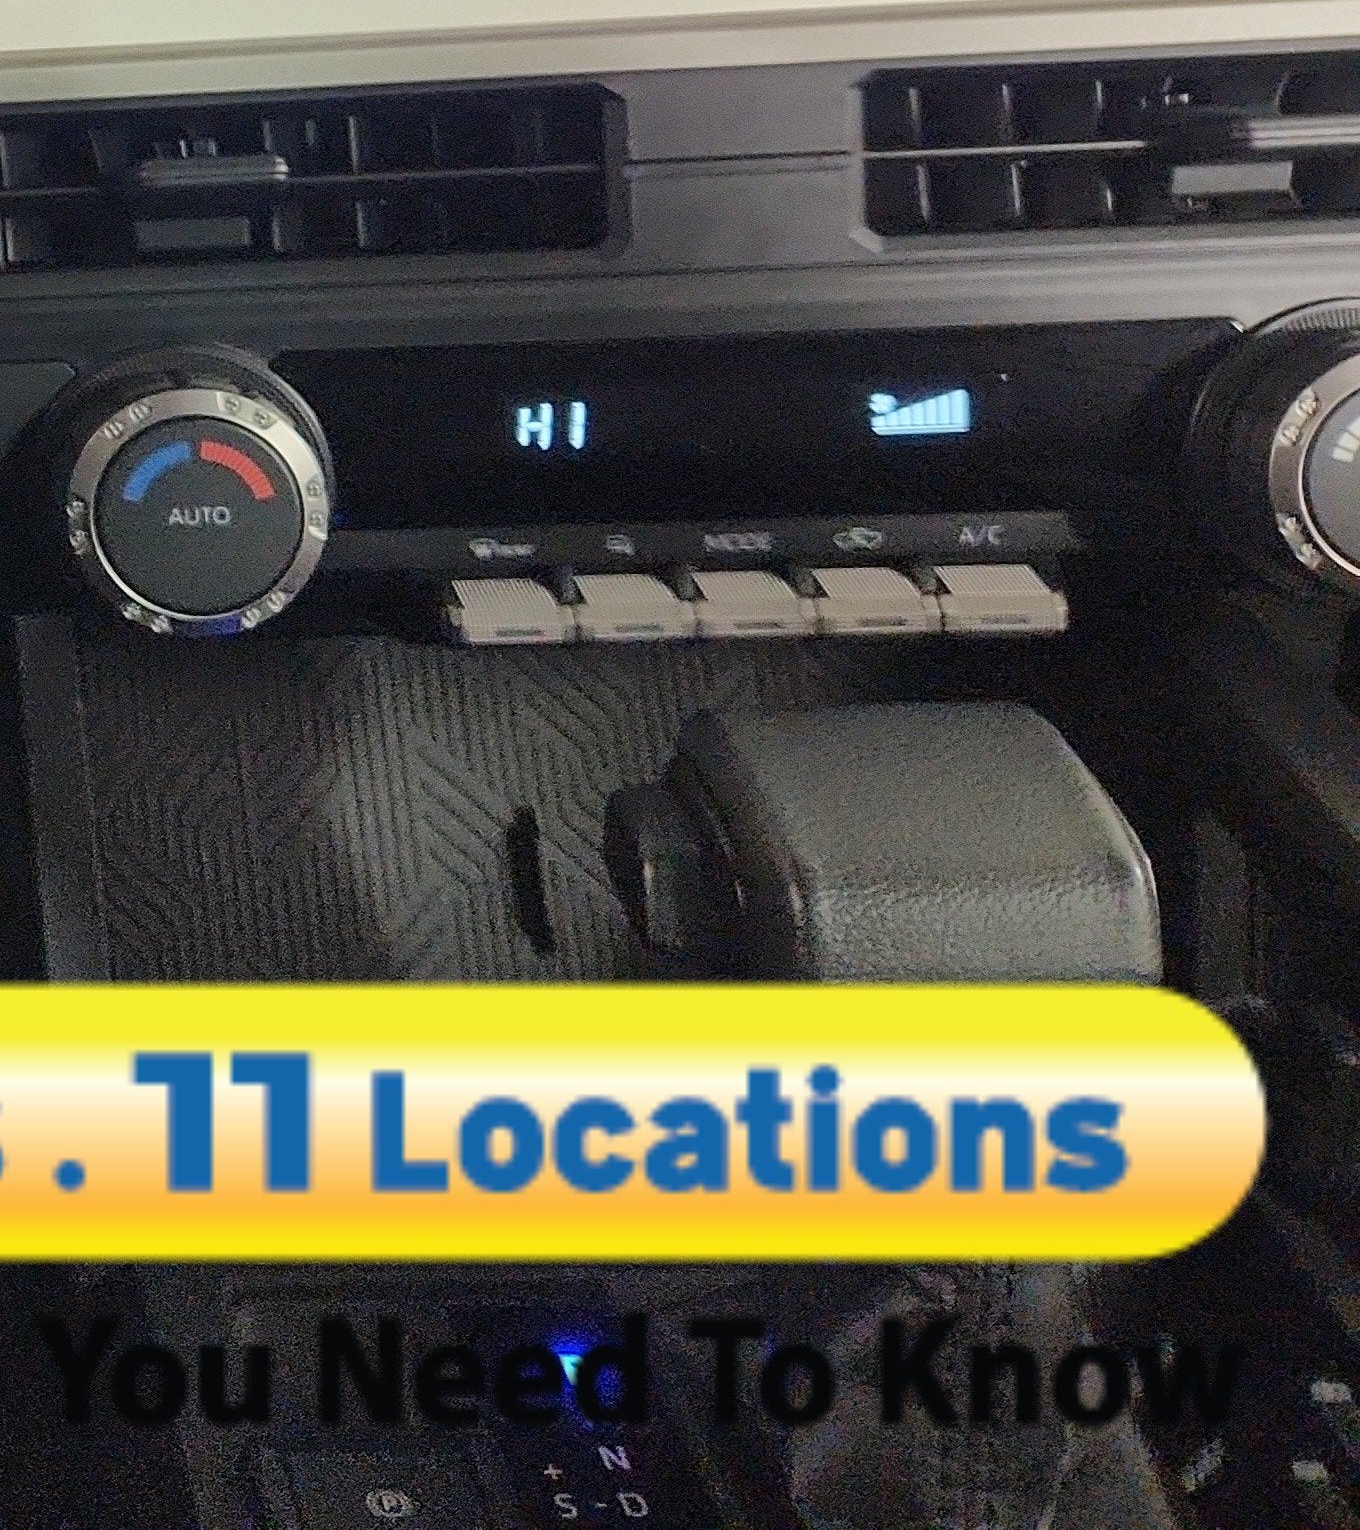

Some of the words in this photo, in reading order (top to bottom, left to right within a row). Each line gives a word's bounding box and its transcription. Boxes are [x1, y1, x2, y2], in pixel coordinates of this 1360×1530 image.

[515, 400, 588, 451] HI
[167, 504, 231, 527] AUTO
[959, 523, 1005, 547] A/C
